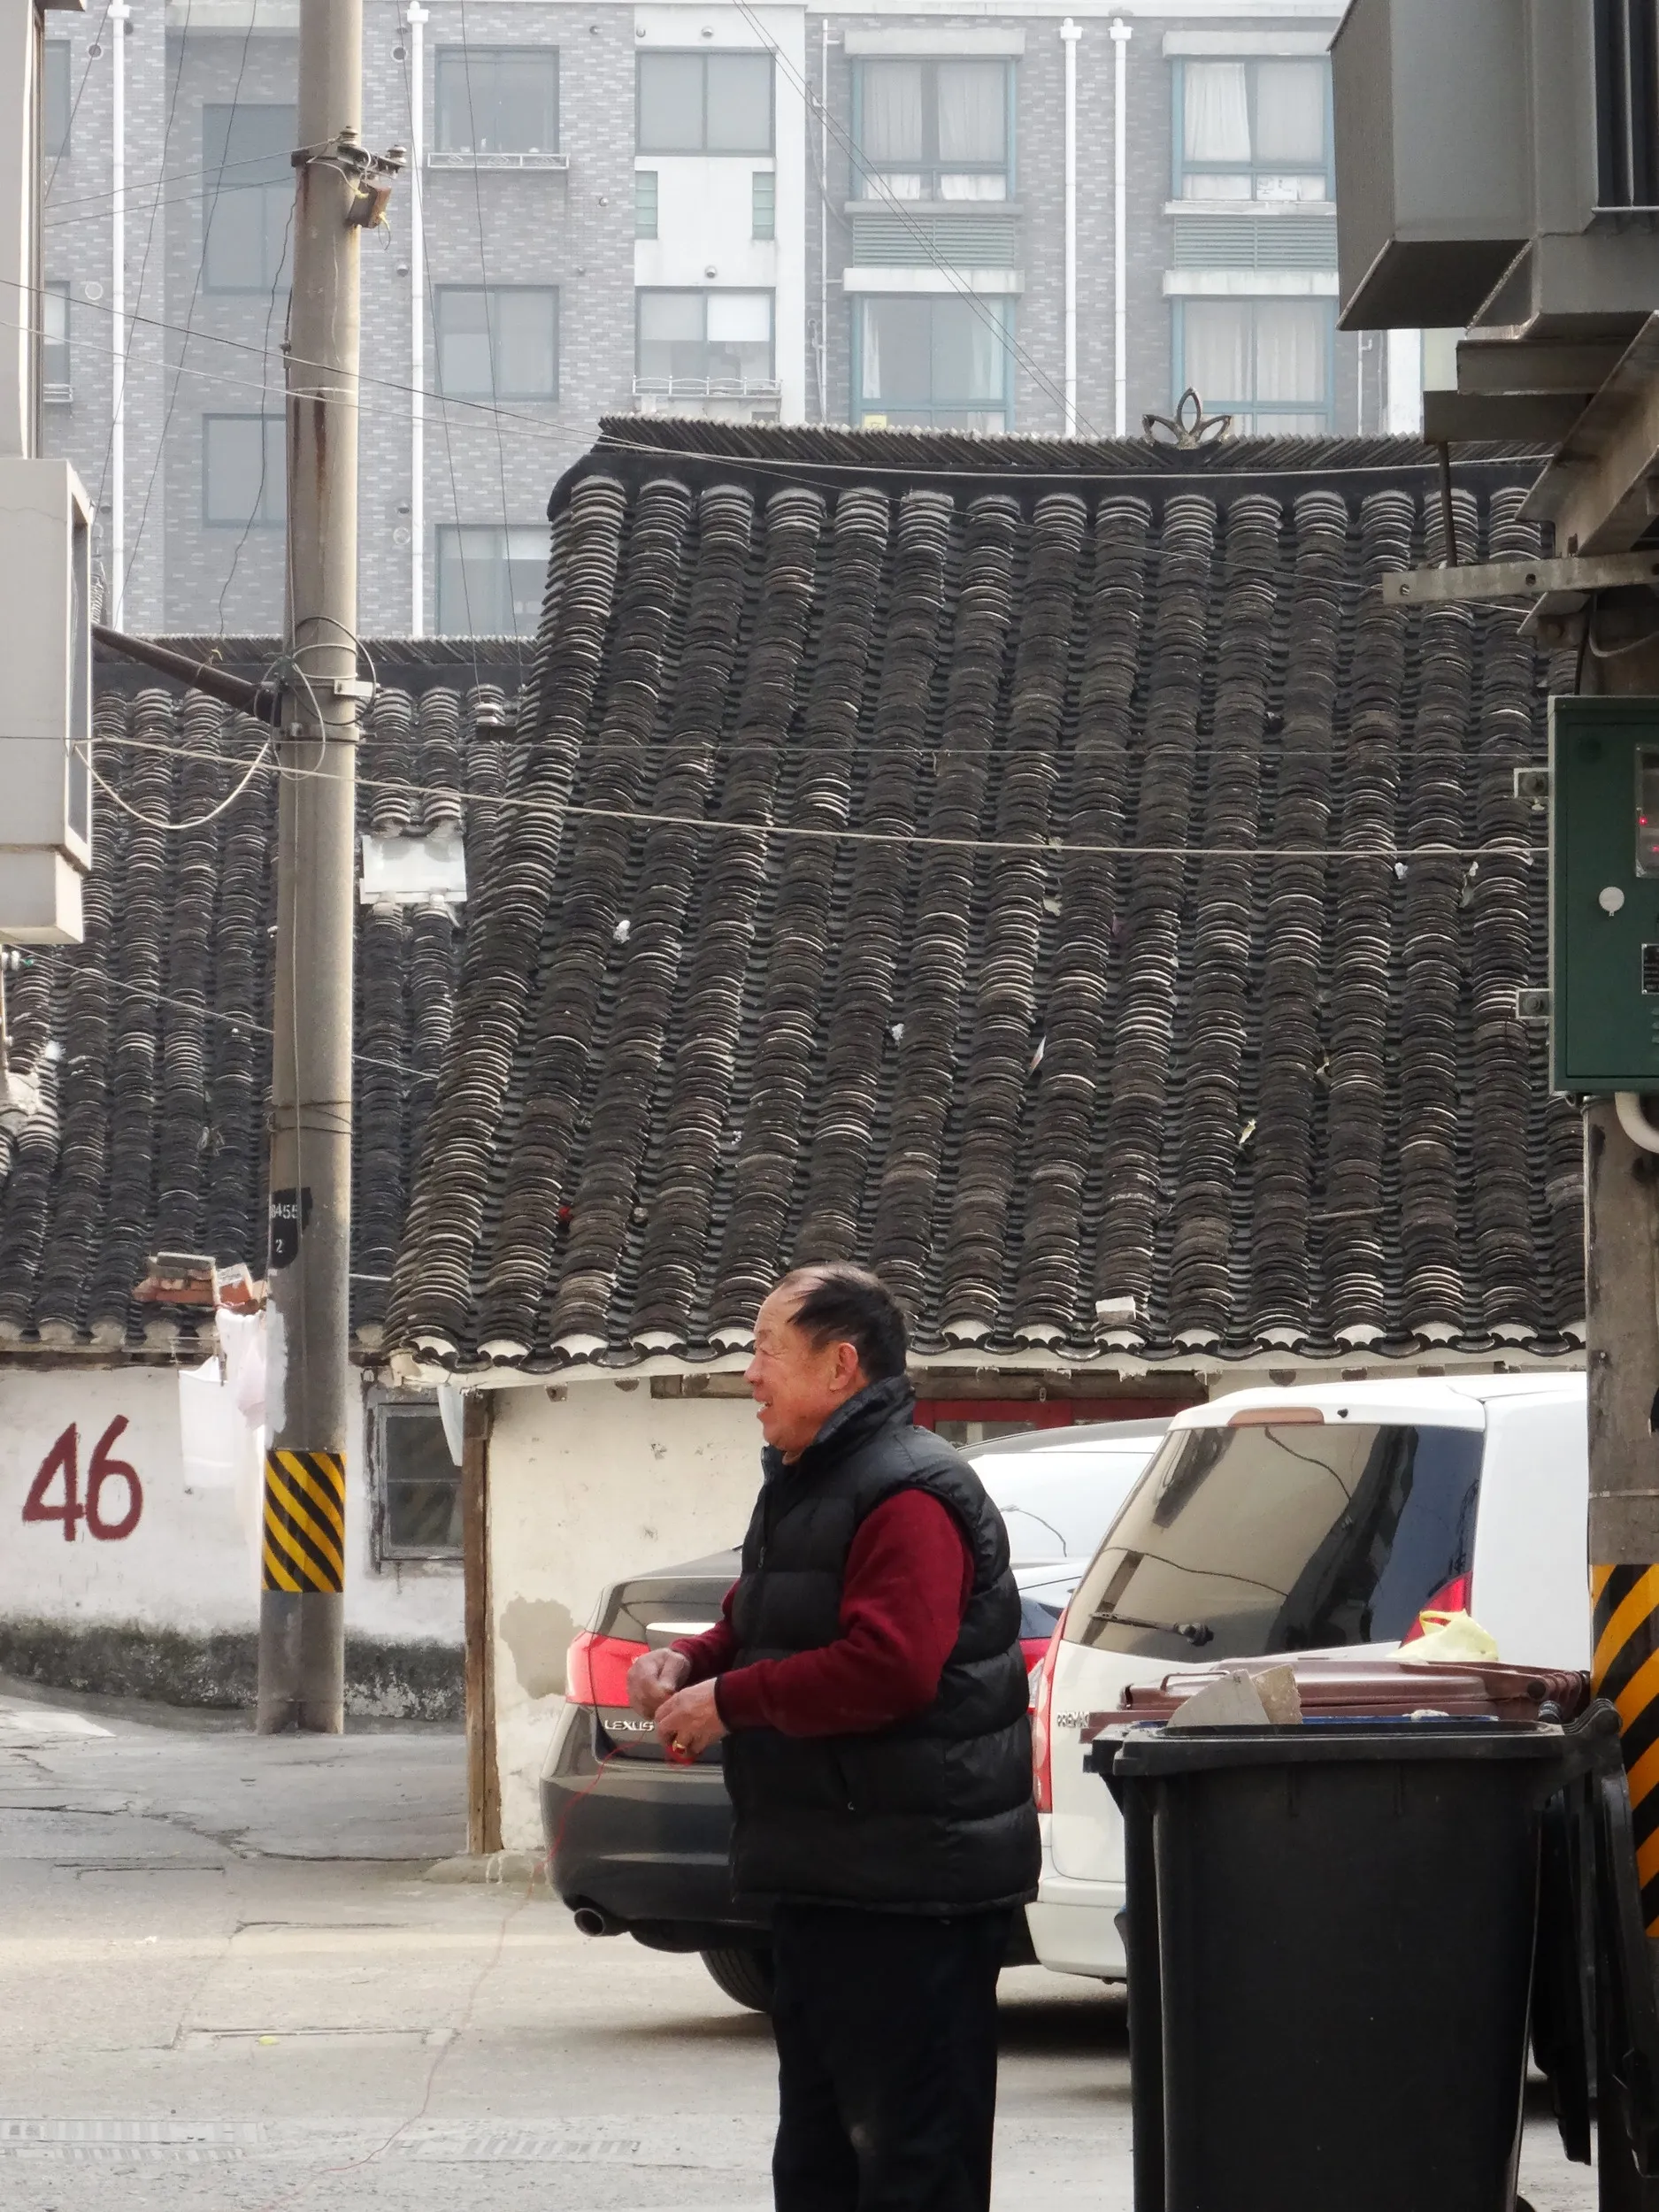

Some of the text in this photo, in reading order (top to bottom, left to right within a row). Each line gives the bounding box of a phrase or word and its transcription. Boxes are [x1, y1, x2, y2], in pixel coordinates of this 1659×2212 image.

[275, 1239, 283, 1254] 2
[22, 1414, 143, 1541] 46
[603, 1719, 655, 1732] LEXUS
